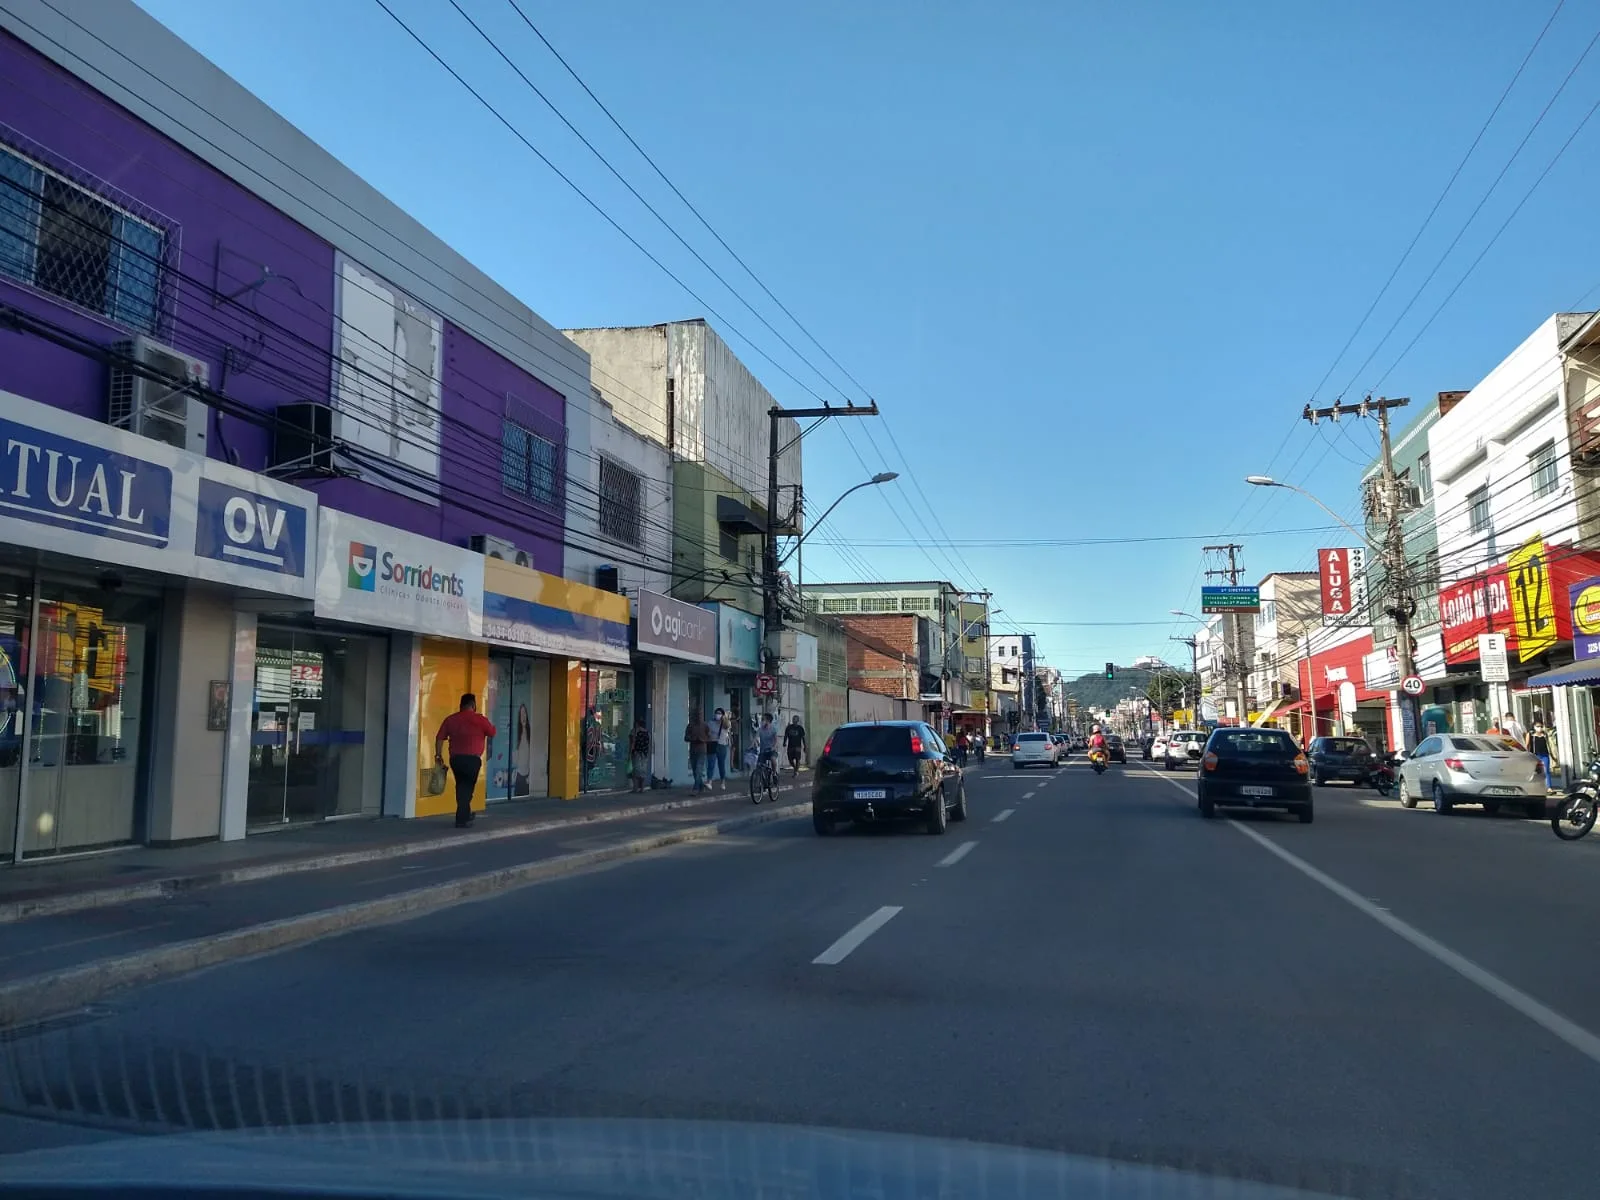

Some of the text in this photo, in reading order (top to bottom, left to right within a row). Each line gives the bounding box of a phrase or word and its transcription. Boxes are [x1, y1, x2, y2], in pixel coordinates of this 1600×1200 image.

[0, 438, 145, 525] TUAL
[222, 496, 287, 551] OV
[1327, 550, 1344, 611] ALUGA
[664, 611, 707, 642] agibank
[1442, 589, 1474, 629] LOJÃO
[1488, 638, 1497, 650] E
[1405, 680, 1420, 689] 40
